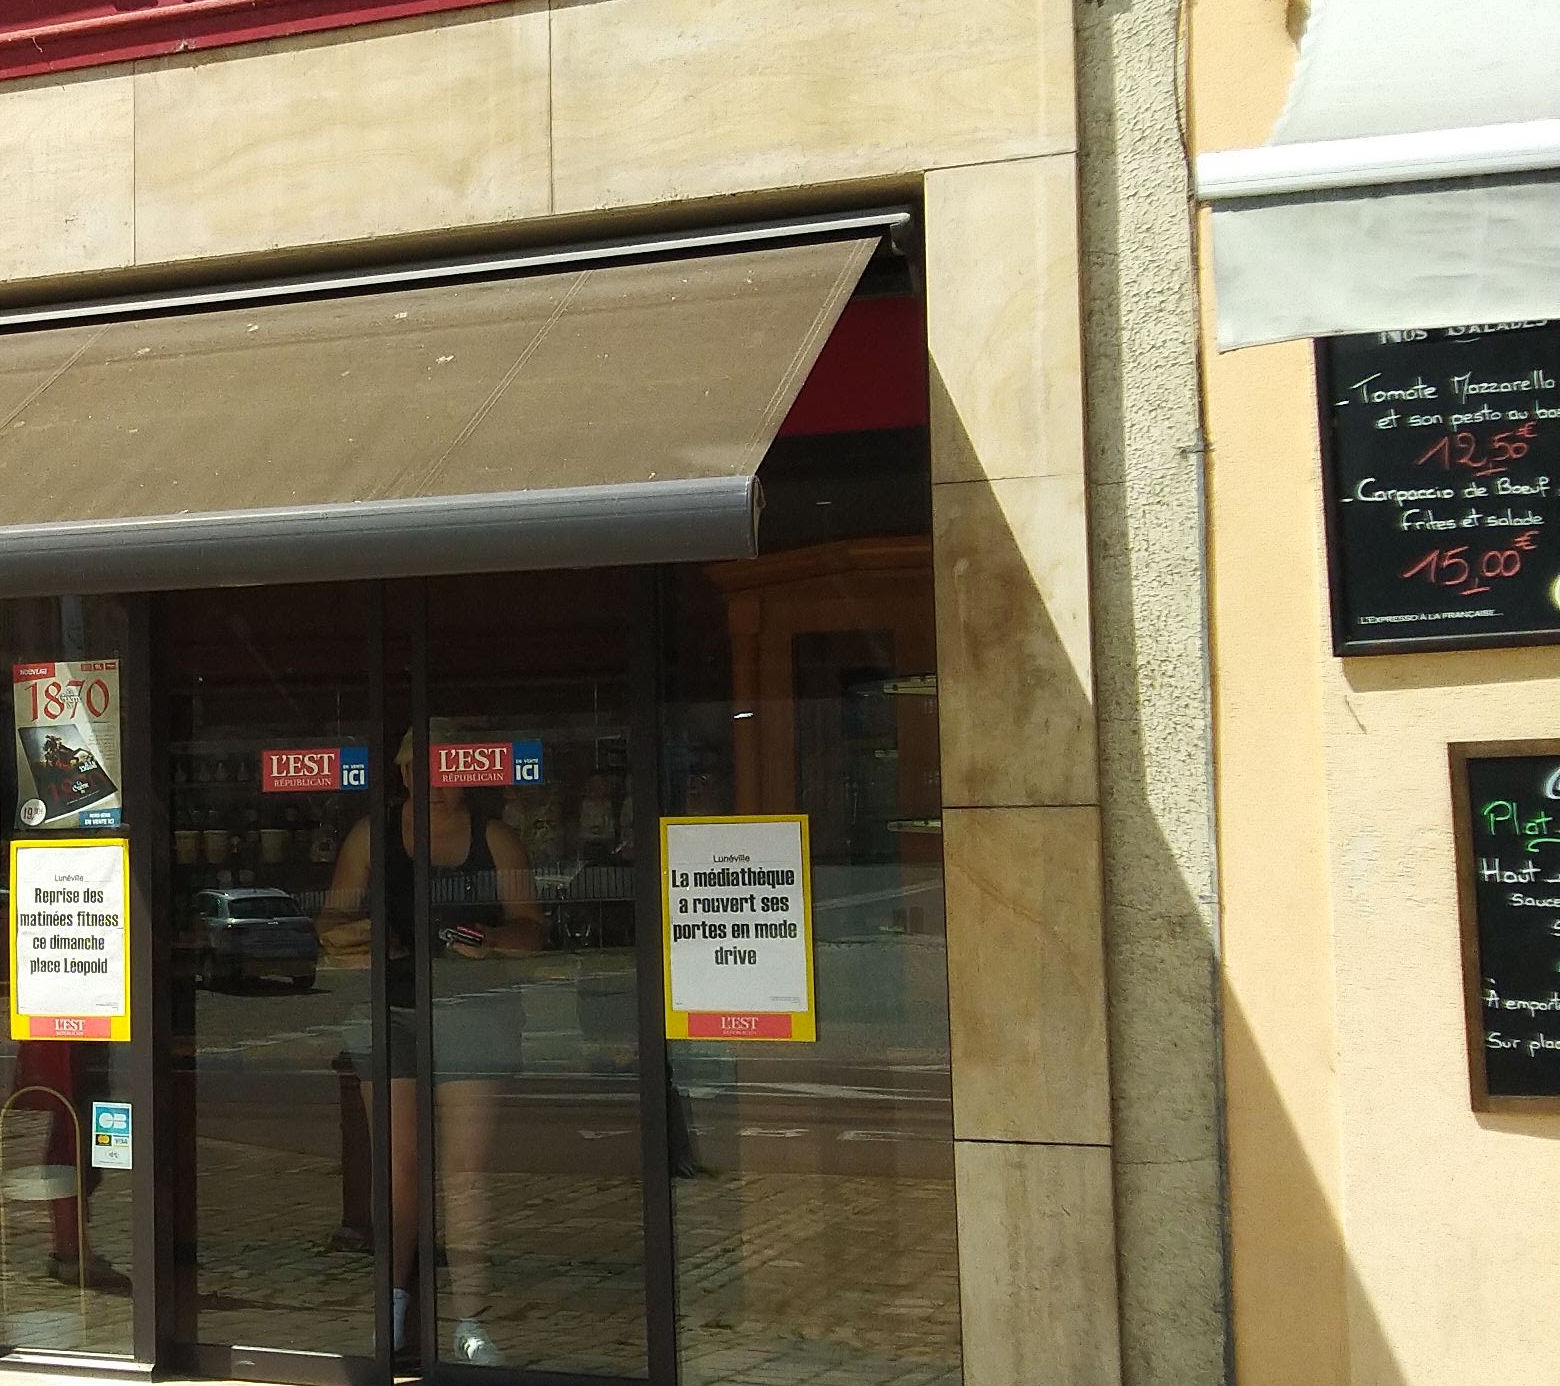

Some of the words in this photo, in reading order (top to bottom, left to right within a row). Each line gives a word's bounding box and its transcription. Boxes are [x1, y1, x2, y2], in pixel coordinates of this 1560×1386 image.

[1350, 372, 1439, 404] Tomate
[1376, 408, 1402, 430] et
[1408, 412, 1444, 427] son
[1449, 403, 1502, 432] pesto
[1357, 477, 1456, 507] Carpaccio
[1463, 481, 1490, 498] de
[1461, 508, 1484, 528] et
[1487, 509, 1545, 527] salade
[24, 679, 110, 722] 1870
[270, 754, 335, 777] L'EST
[439, 748, 507, 772] L'EST
[1483, 800, 1553, 836] Plat
[672, 870, 689, 887] La
[694, 867, 795, 889] médiathèque
[34, 888, 80, 906] Reprise
[83, 888, 104, 904] des
[679, 898, 688, 914] a
[693, 894, 756, 914] rouvert
[761, 896, 789, 912] ses
[20, 911, 73, 927] matinées
[77, 911, 119, 927] fitness
[673, 921, 727, 942] portes
[731, 923, 750, 939] en
[754, 920, 797, 939] mode
[32, 936, 47, 949] ce
[50, 935, 105, 950] dimanche
[715, 946, 757, 965] drive
[30, 958, 61, 975] place
[64, 958, 108, 976] Léopold
[1487, 1032, 1521, 1049] Sur
